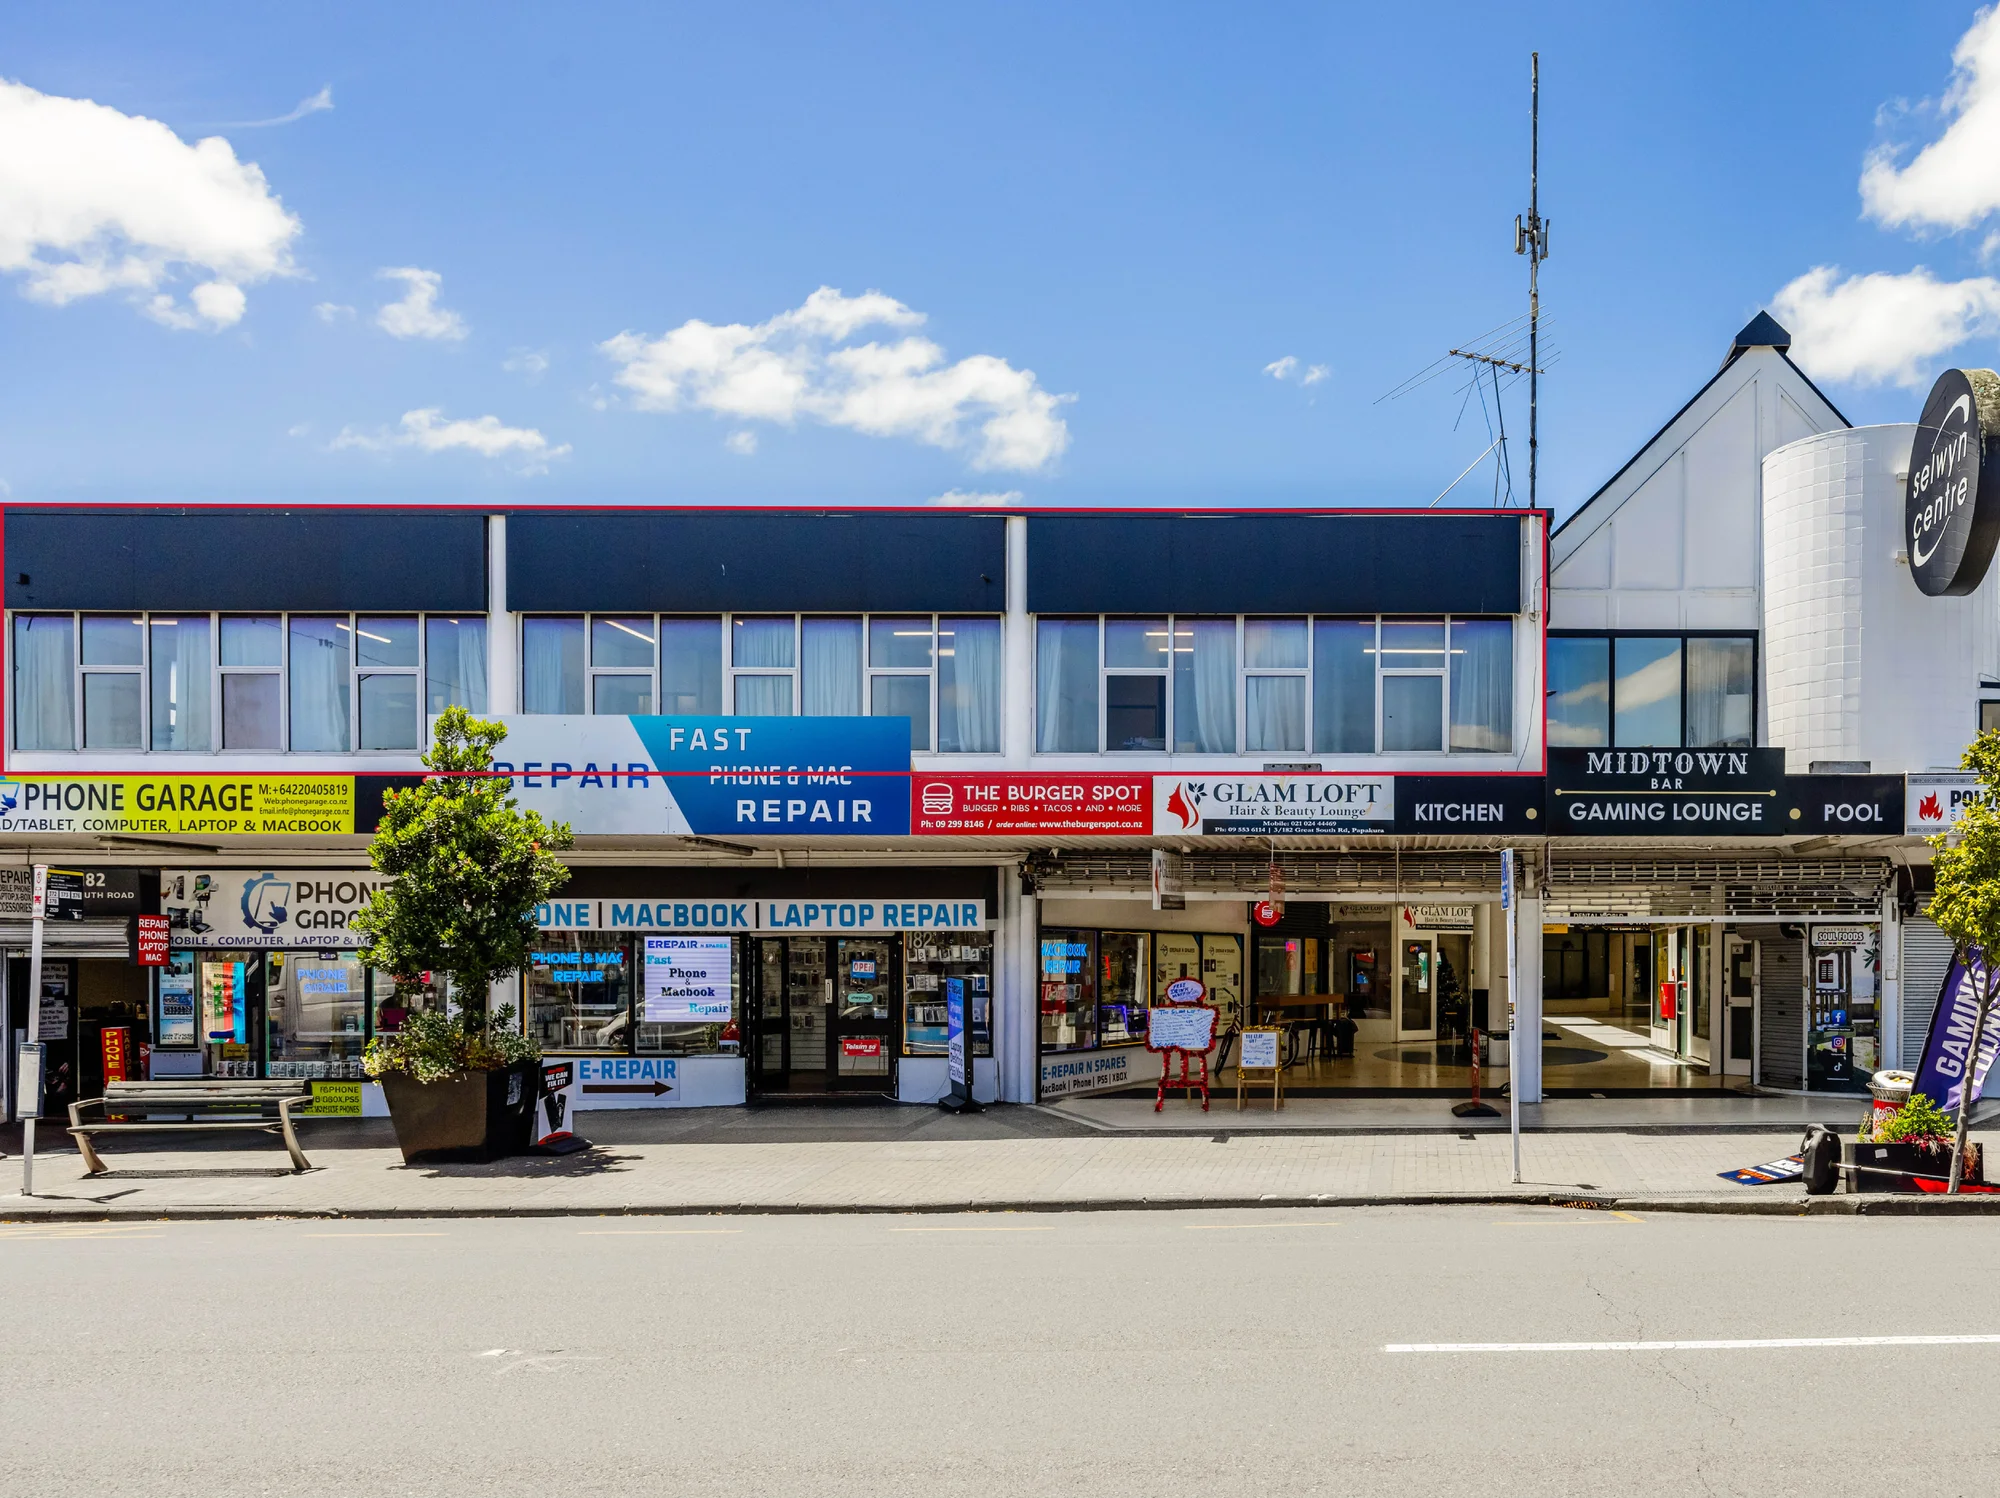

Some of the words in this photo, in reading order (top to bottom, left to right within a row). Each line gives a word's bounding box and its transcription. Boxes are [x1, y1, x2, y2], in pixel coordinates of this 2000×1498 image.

[1913, 430, 1968, 499] selwyn
[1913, 476, 1968, 540] centre
[669, 728, 752, 751] FAST
[1586, 752, 1748, 775] MIDTOWN
[710, 765, 781, 785] PHONE
[787, 765, 799, 785] &
[806, 765, 852, 785] MAC
[258, 784, 348, 796] M:+64220405819
[1651, 778, 1683, 789] BAR
[24, 783, 125, 811] PHONE
[136, 784, 253, 812] GARAGE
[963, 786, 1000, 800] THE
[1008, 786, 1084, 801] BURGER
[1092, 786, 1142, 801] SPOT
[1213, 783, 1297, 803] GLAM
[1306, 784, 1382, 803] LOFT
[264, 798, 348, 806] Web:phonegarage.co.nz
[963, 804, 998, 812] BURGER
[1010, 804, 1030, 812] RIBS
[1043, 804, 1073, 812] TACOS
[1085, 804, 1104, 812] AND
[1117, 804, 1142, 812] MORE
[736, 800, 873, 822] REPAIR
[1229, 805, 1257, 816] Hair
[1260, 806, 1270, 816] &
[1274, 805, 1316, 819] Beauty
[1320, 806, 1366, 819] Lounge
[1414, 803, 1504, 821] KITCHEN
[1568, 802, 1665, 821] GAMING
[1673, 802, 1762, 821] LOUNGE
[1824, 803, 1883, 822] POOL
[0, 818, 76, 832] D/TABLET,
[83, 819, 171, 833] COMPUTER,
[179, 820, 238, 831] LAPTOP
[243, 820, 256, 832] &
[263, 820, 342, 832] MACBOOK
[920, 820, 934, 828] Ph:
[936, 820, 946, 828] 09
[948, 820, 962, 828] 299
[964, 820, 984, 828] 8146
[996, 820, 1014, 828] order
[1015, 820, 1038, 828] online:
[1039, 820, 1143, 830] www.theburgerspot.co.nz
[0, 870, 31, 884] EPAIR
[86, 873, 106, 886] 82
[534, 904, 590, 927] ONE
[612, 904, 748, 927] MACBOOK
[770, 904, 874, 927] LAPTOP
[883, 904, 978, 927] REPAIR
[1421, 906, 1449, 917] GLAM
[138, 919, 169, 928] REPAIR
[295, 910, 358, 928] GAR
[139, 931, 168, 940] PHONE
[218, 936, 284, 945] COMPUTER
[294, 936, 340, 945] LAPTOP
[343, 936, 352, 945] &
[907, 931, 933, 949] 182
[1818, 932, 1837, 941] SOUL
[1838, 932, 1865, 941] FOODS
[138, 943, 169, 951] LAPTOP
[647, 940, 698, 948] EREPAIR
[145, 953, 162, 961] MAC
[531, 952, 580, 964] PHONE
[582, 952, 593, 964] &
[594, 952, 623, 964] MAC
[646, 955, 672, 965] Fast
[669, 968, 707, 978] Phone
[853, 962, 874, 972] OPEN
[553, 970, 604, 982] REPAIR
[661, 987, 715, 997] Macbook
[689, 1003, 728, 1015] Repair
[1936, 967, 1987, 1078] GAMING
[106, 1031, 120, 1068] PHONE
[579, 1060, 676, 1079] E-REPAIR
[1042, 1062, 1084, 1080] E-REPAIR
[1086, 1060, 1092, 1073] N
[1094, 1056, 1127, 1072] SPARES
[545, 1073, 555, 1081] WE
[555, 1071, 568, 1079] CAN
[1073, 1078, 1091, 1089] Phone
[1097, 1075, 1108, 1084] PS5
[1112, 1072, 1128, 1082] XBOX
